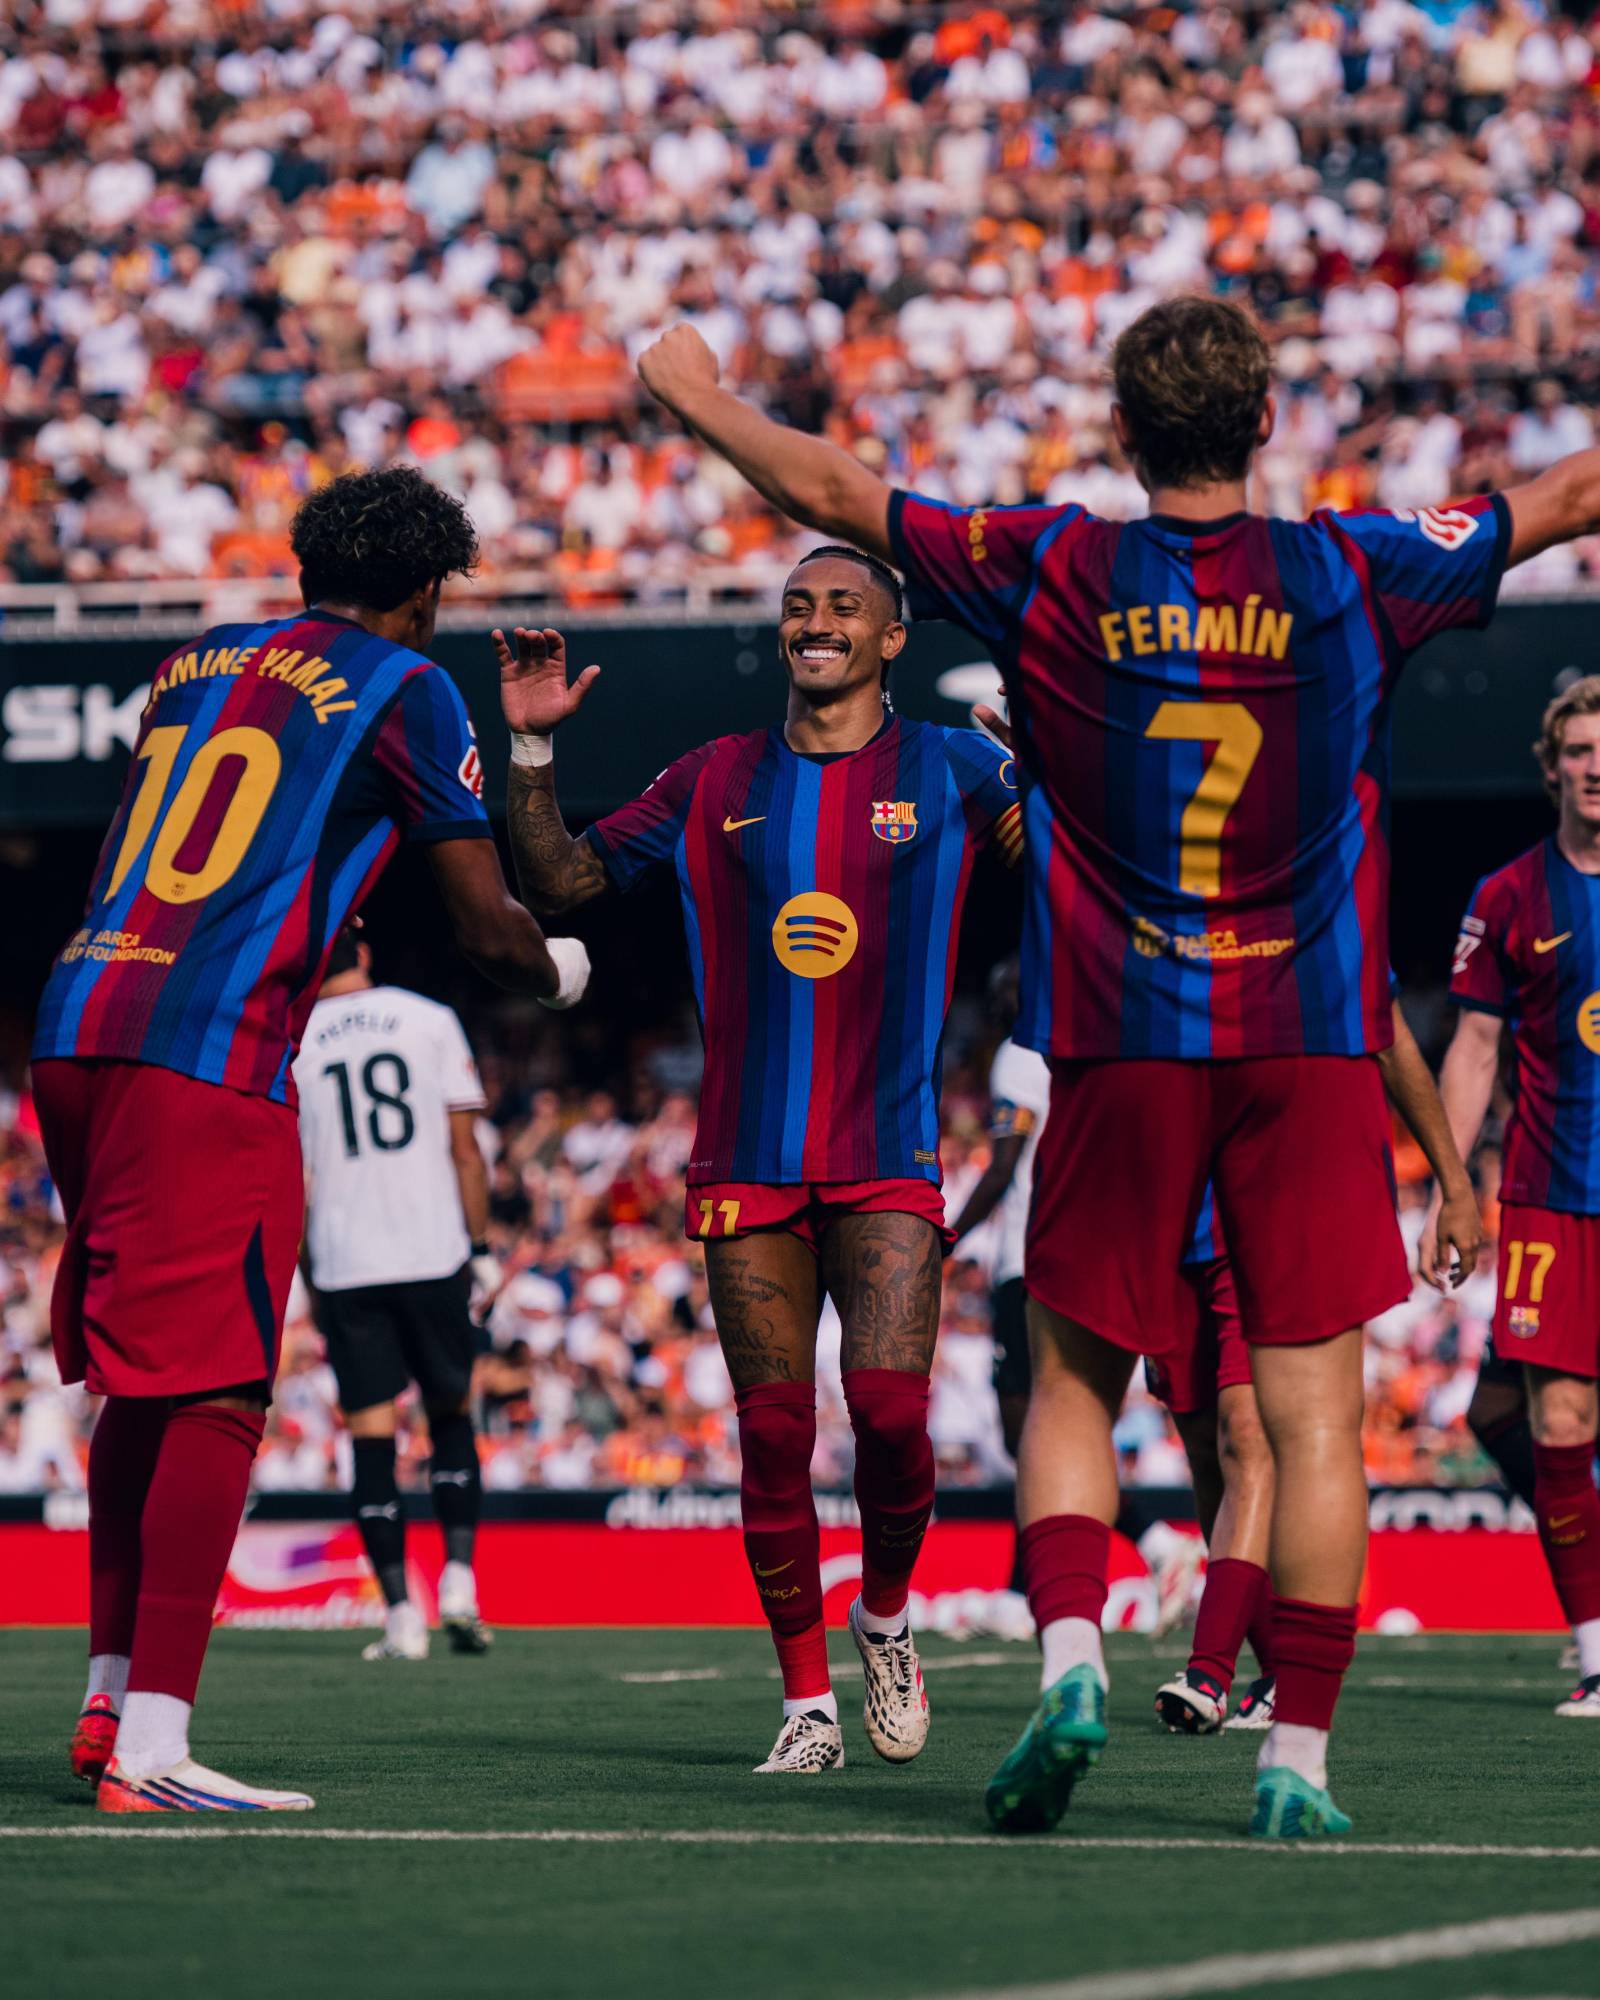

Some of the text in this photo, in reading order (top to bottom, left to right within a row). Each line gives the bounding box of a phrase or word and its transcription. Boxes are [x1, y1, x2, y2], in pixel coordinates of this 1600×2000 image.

[1098, 594, 1293, 662] FERMÍN
[257, 647, 358, 725] YAMAL
[102, 724, 283, 905] 10
[1144, 701, 1264, 898] 7
[323, 1053, 415, 1159] 18
[699, 1199, 741, 1237] 11
[1504, 1240, 1556, 1302] 17
